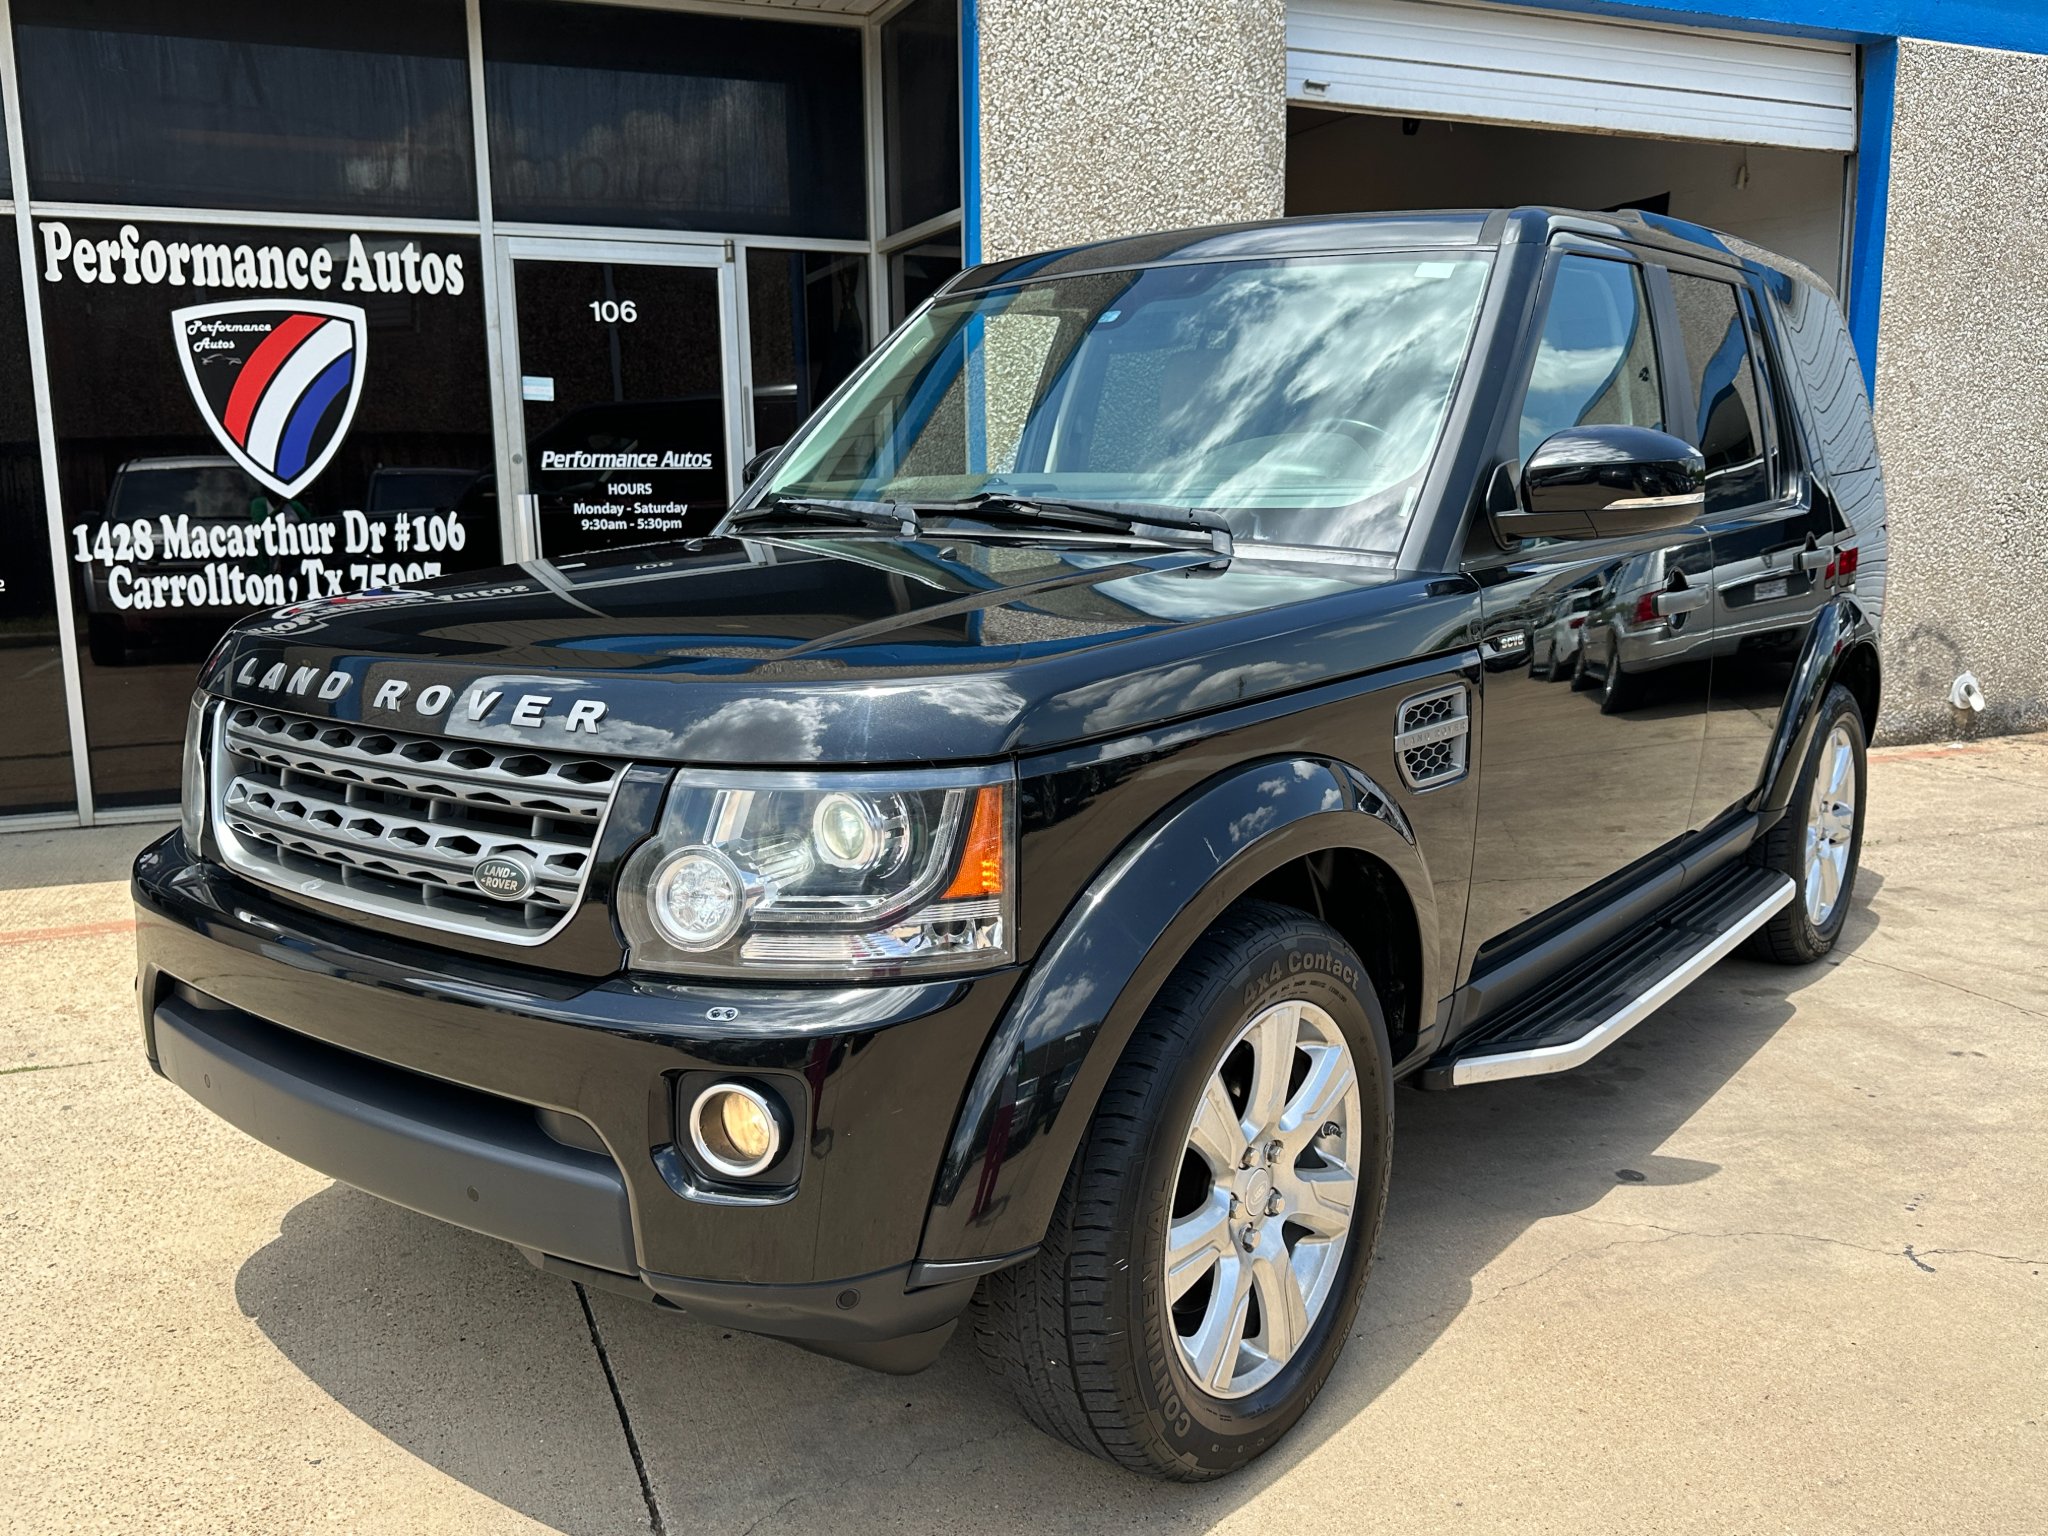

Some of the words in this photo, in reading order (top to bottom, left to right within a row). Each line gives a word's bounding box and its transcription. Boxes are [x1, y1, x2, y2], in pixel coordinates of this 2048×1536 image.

[39, 221, 333, 290] Performance
[341, 229, 467, 296] Autos
[588, 300, 638, 323] 106
[187, 320, 273, 337] Performance
[193, 337, 236, 353] Autos
[541, 450, 658, 470] Performance
[660, 450, 713, 470] Autos
[607, 482, 653, 496] HOURS
[573, 501, 625, 517] Monday
[633, 501, 688, 517] Saturday
[581, 518, 628, 531] 9:30am
[636, 517, 683, 532] 5:30pm
[73, 519, 154, 567] 1428
[159, 513, 336, 560] Macarthur
[343, 509, 387, 554] Dr
[395, 510, 466, 553] #106
[108, 562, 297, 611] Carrollton,
[301, 558, 344, 600] Tx
[237, 658, 353, 700] LAND
[373, 679, 608, 734] ROVER
[484, 865, 511, 878] LAND
[485, 876, 518, 891] ROVER
[1243, 959, 1282, 1005] 4x4
[1288, 950, 1360, 990] Contact
